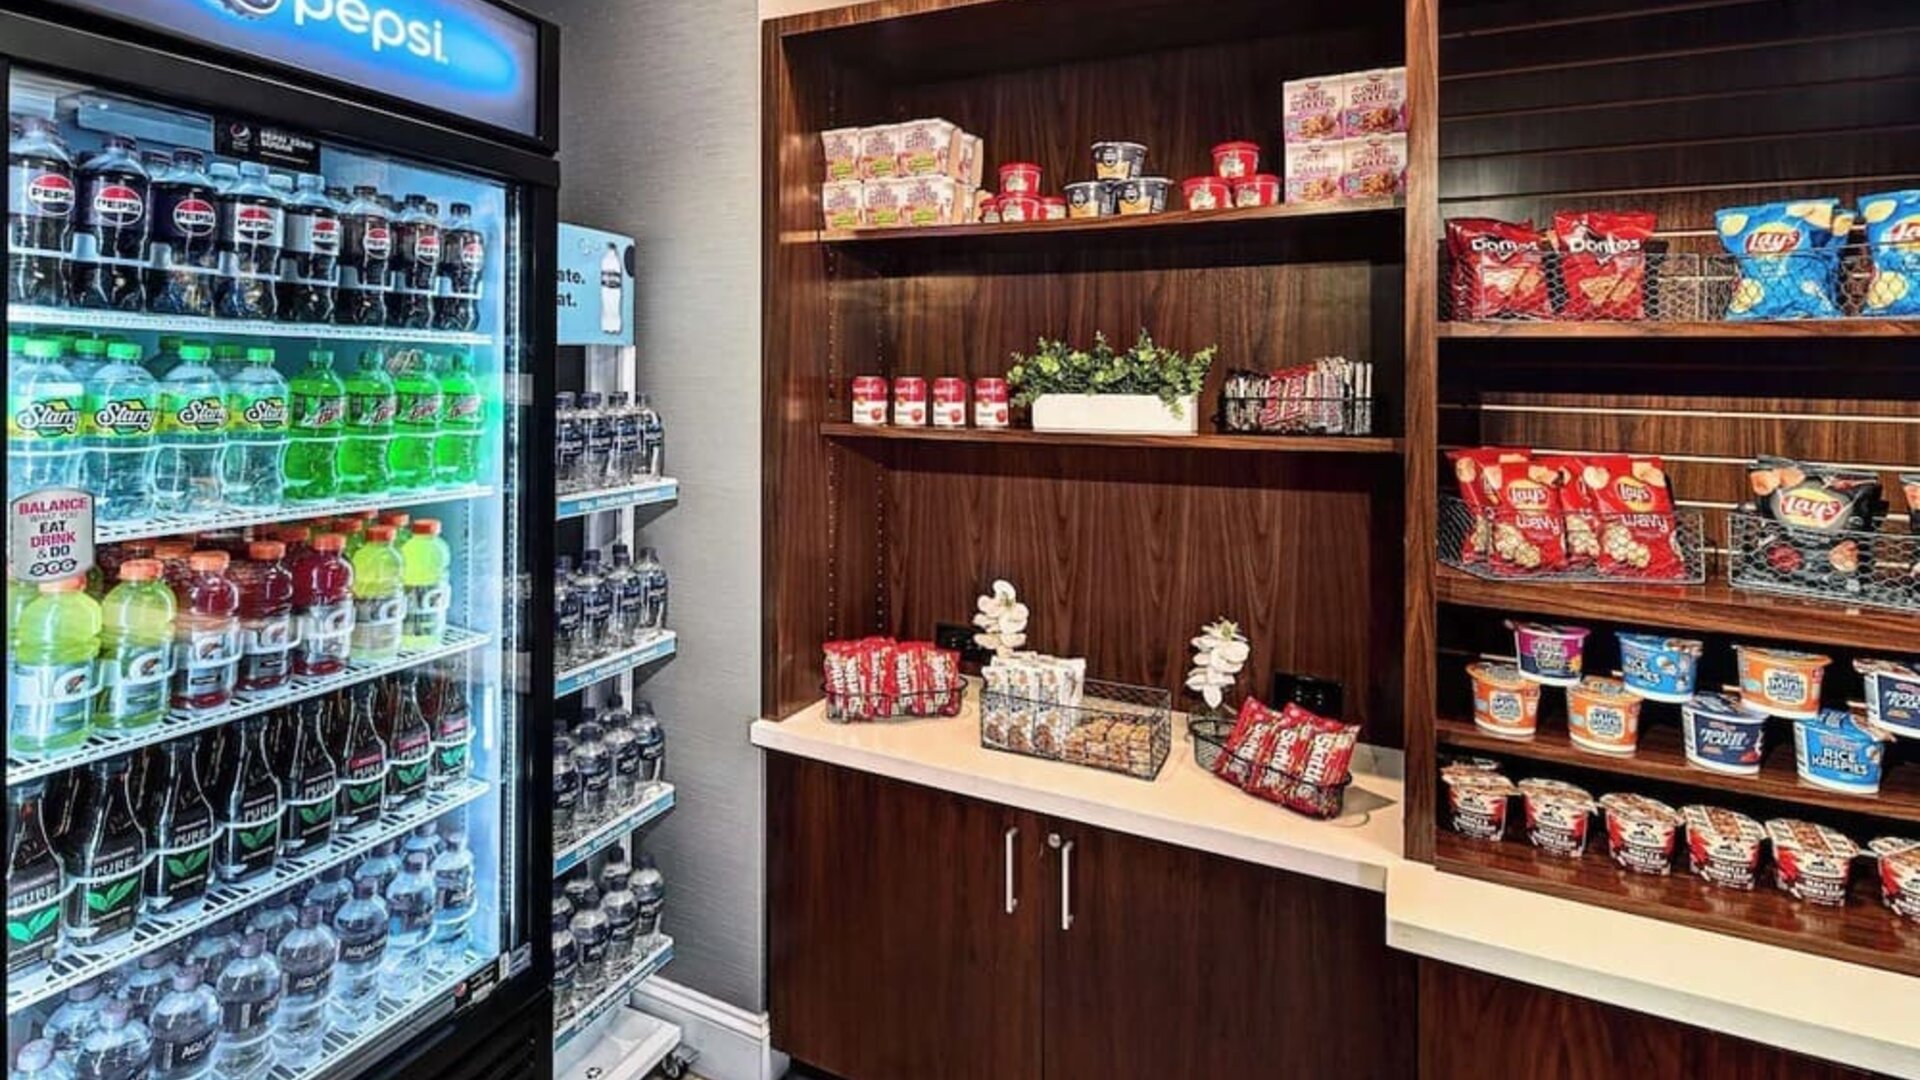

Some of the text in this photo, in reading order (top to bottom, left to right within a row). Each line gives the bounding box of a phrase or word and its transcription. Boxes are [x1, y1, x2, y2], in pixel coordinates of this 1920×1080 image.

[294, 0, 446, 62] pepsi
[176, 211, 214, 224] PEPSI
[237, 218, 274, 230] PEPSI
[1568, 232, 1641, 254] Doritos
[1747, 228, 1800, 254] Lay's
[19, 497, 89, 515] BALANCE
[1782, 495, 1842, 521] Lay's
[39, 520, 66, 533] EAT
[31, 531, 76, 548] DRINK
[50, 545, 70, 558] DO
[1823, 747, 1856, 763] RICE
[92, 855, 135, 877] PURE
